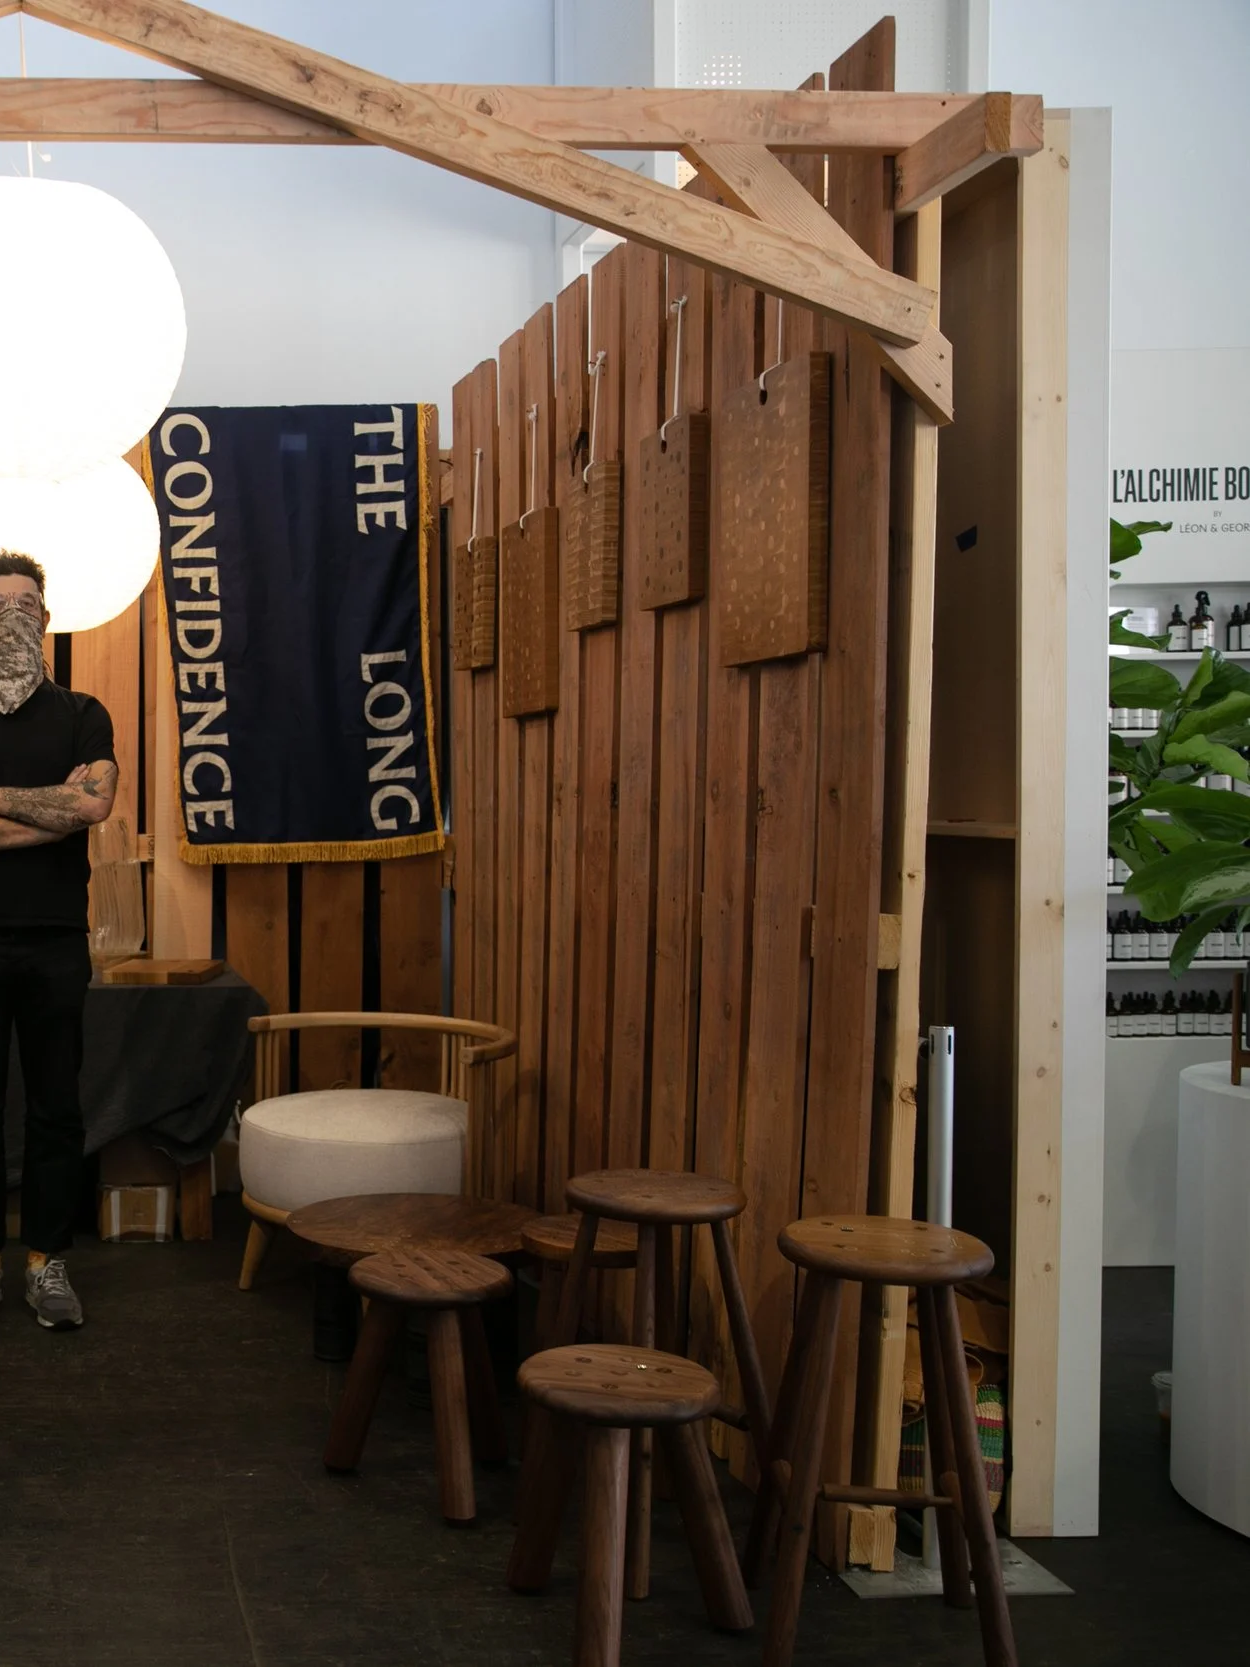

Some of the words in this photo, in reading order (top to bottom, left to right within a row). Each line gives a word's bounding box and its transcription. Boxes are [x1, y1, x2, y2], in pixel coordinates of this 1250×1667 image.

[353, 405, 407, 535] THE
[1225, 466, 1250, 500] BO
[1179, 523, 1207, 534] LÉON
[1210, 523, 1218, 533] &
[1221, 522, 1250, 533] GEOR
[1213, 510, 1222, 518] BY
[160, 413, 235, 833] CONFIDENCE
[360, 649, 421, 831] LONG
